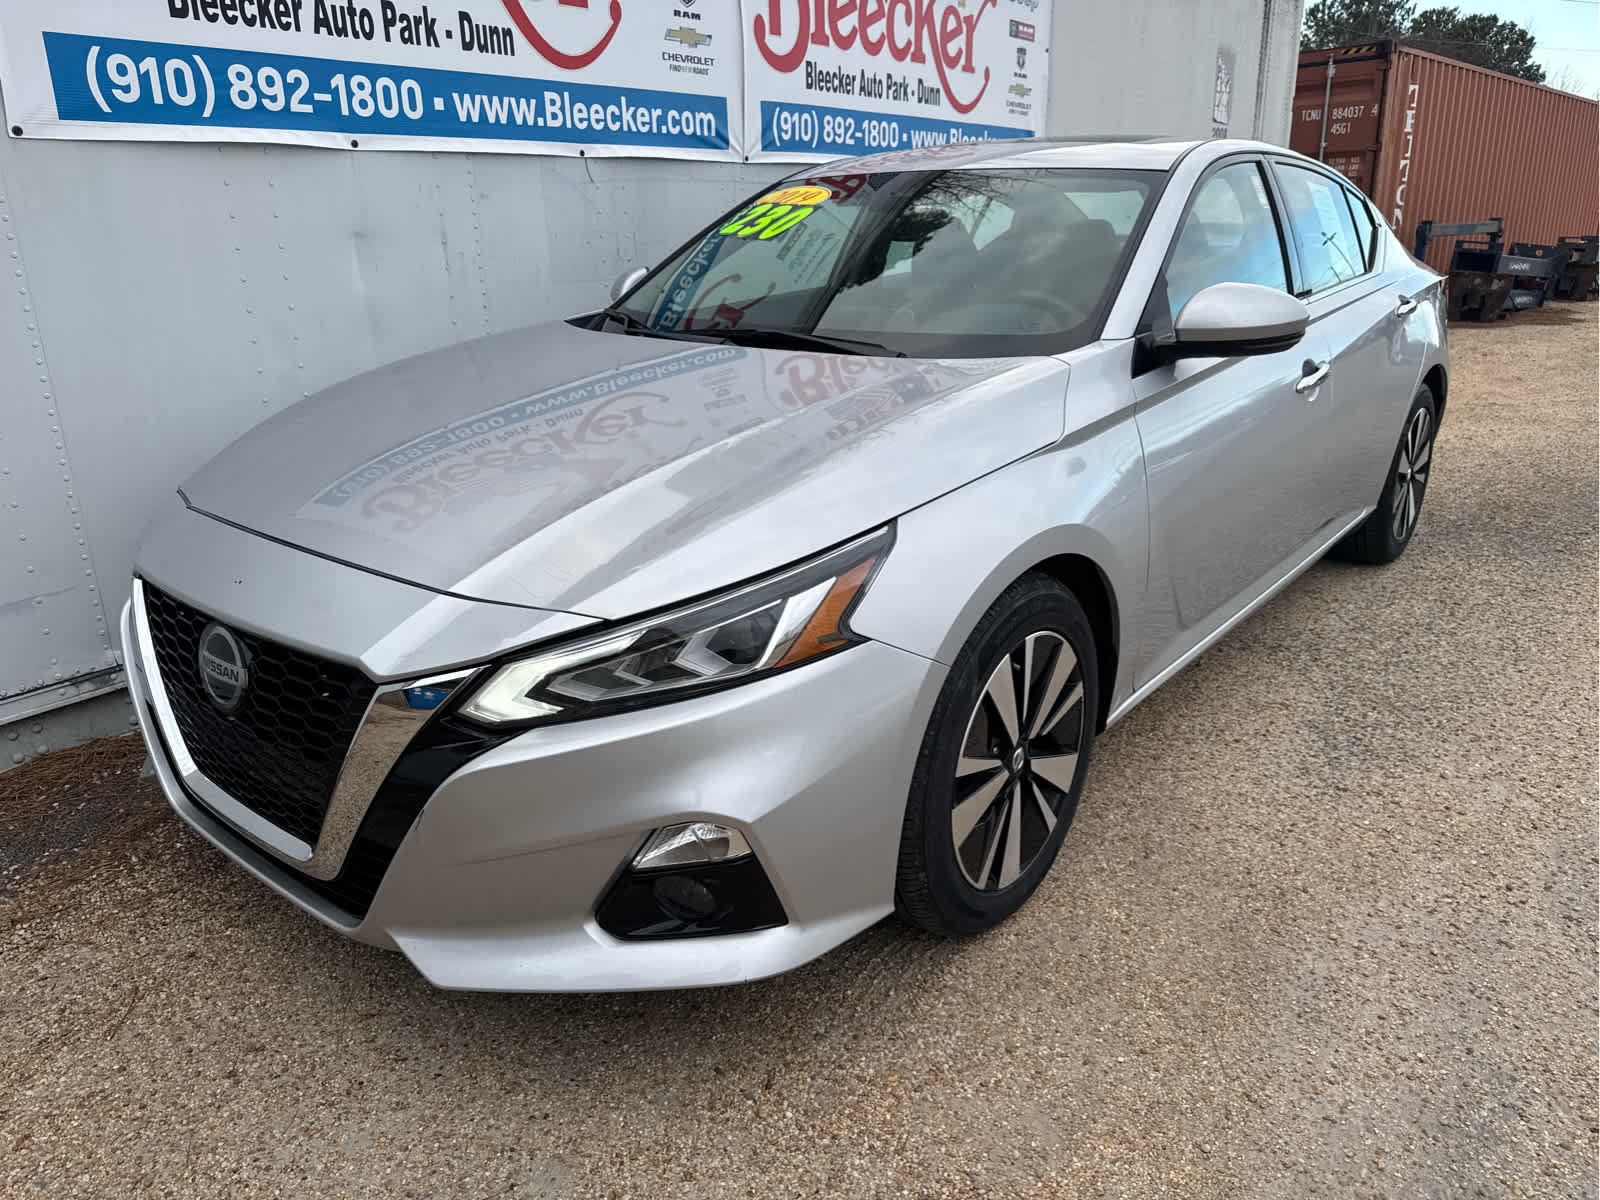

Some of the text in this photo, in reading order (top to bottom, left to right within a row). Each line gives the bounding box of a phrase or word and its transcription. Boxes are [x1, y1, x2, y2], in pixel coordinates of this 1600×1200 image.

[314, 0, 374, 41] Auto
[381, 0, 440, 48] Park
[458, 11, 515, 56] Dunn
[673, 9, 701, 20] RAM
[662, 51, 714, 66] CHEVROLET
[86, 46, 716, 137] (910) 892-1800 www.Bleecker.com
[806, 60, 941, 106] Bleecker Auto Park Dunn
[772, 107, 819, 149] (910)
[823, 116, 899, 148] 892-1800
[1301, 109, 1322, 121] TCNU
[1332, 106, 1364, 120] 884037
[719, 203, 814, 240] 230
